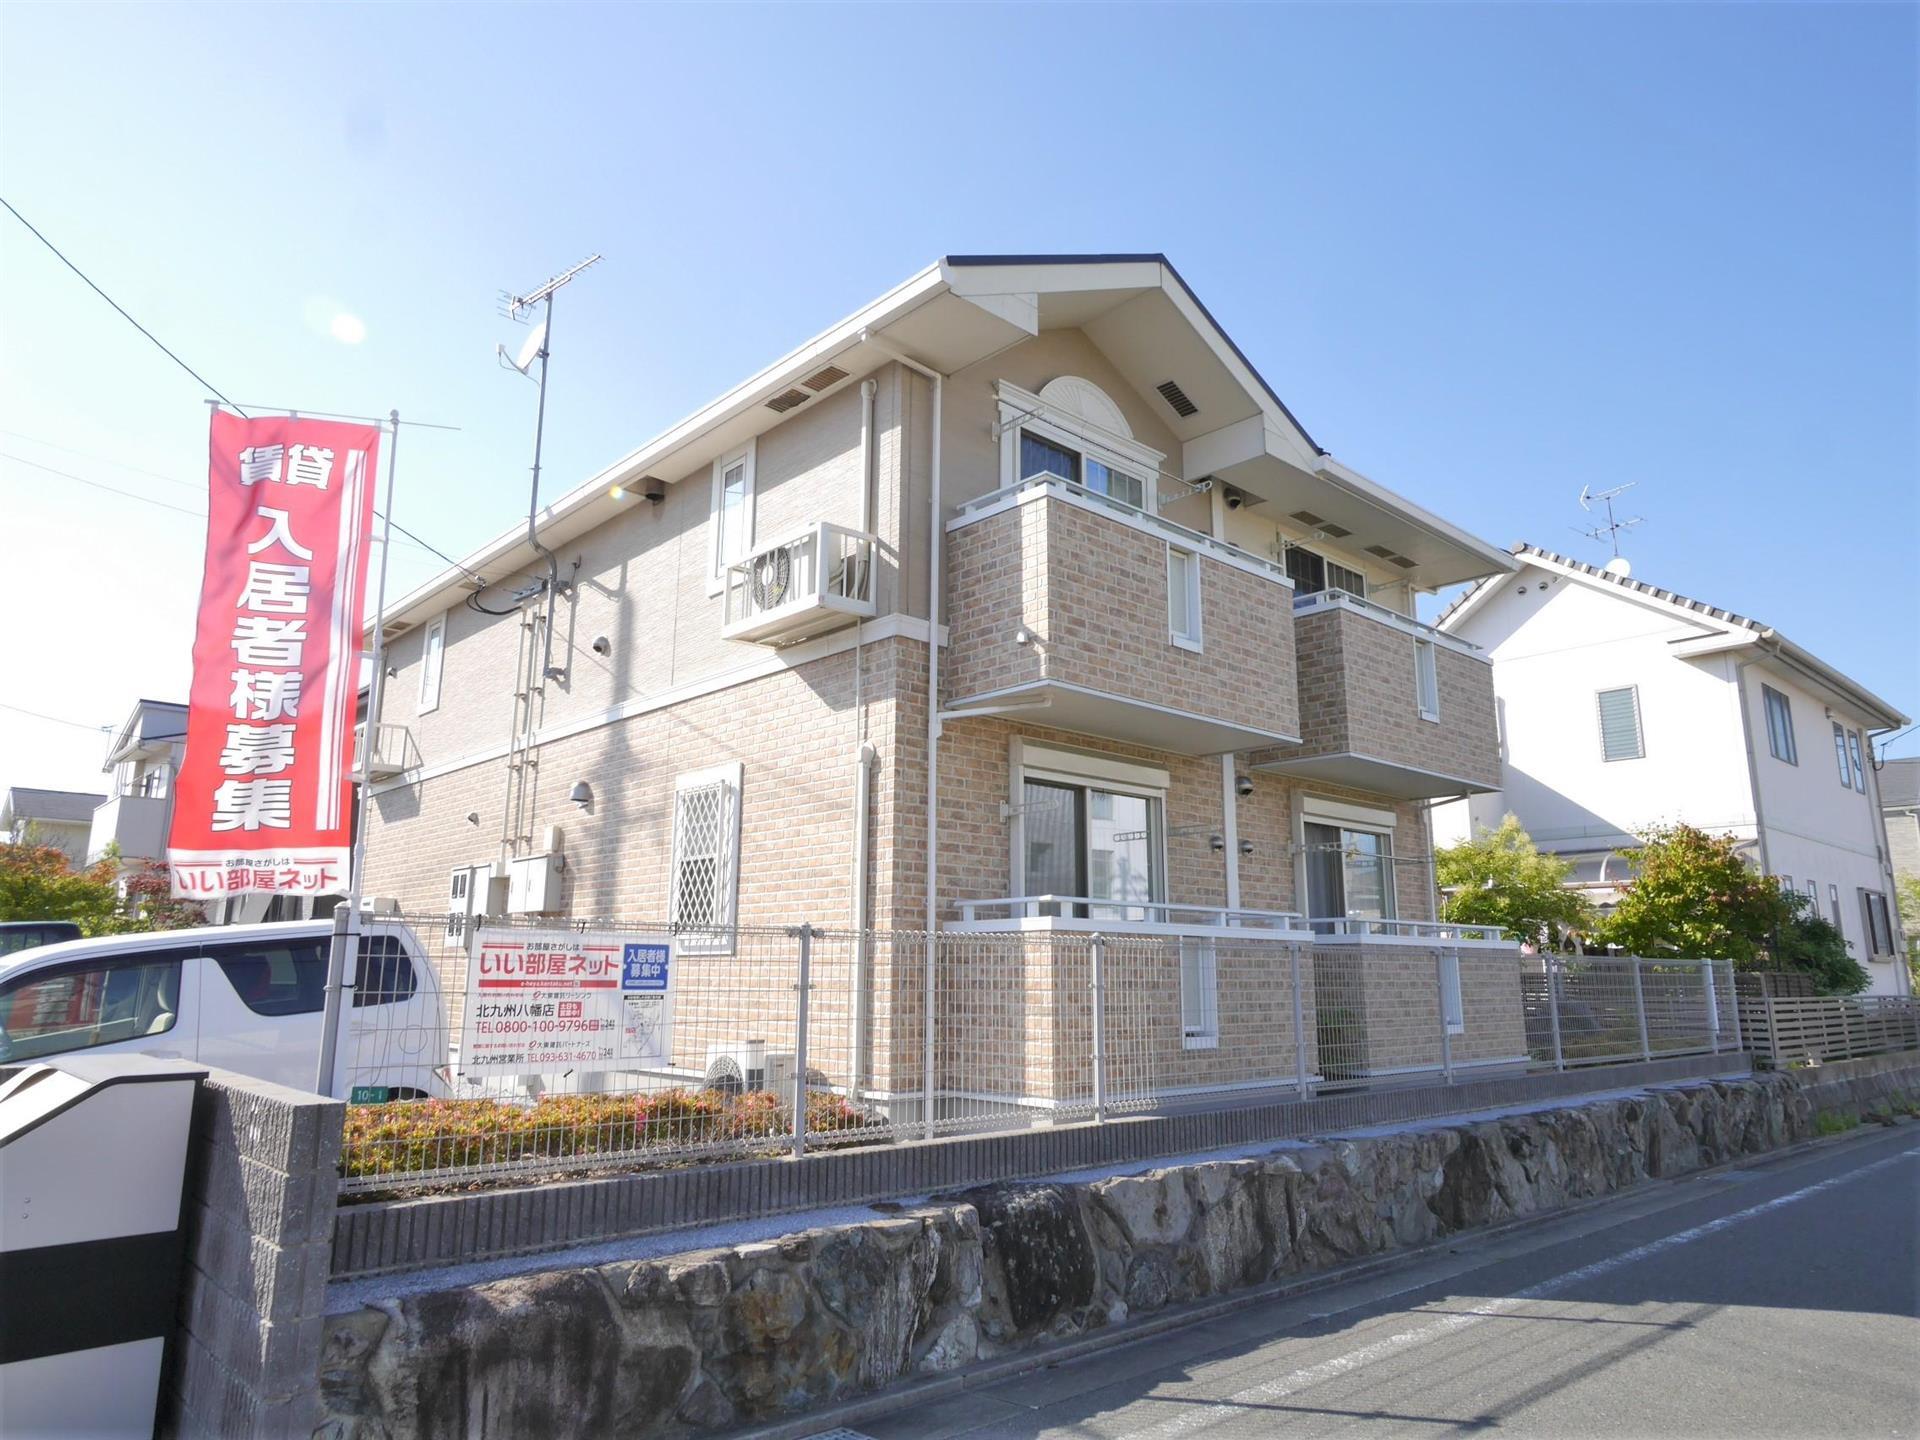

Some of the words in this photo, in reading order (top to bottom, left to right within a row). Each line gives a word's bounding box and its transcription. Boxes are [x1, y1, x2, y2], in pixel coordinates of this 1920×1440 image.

[239, 443, 335, 490] 賃貸
[211, 506, 314, 832] 入居者様募集
[226, 858, 290, 868] お部屋さがしは
[176, 868, 338, 892] いい部屋ネット
[526, 942, 580, 951] お部屋さがしは
[479, 952, 619, 976] いい部屋ネット
[627, 949, 666, 964] 入居者様
[630, 963, 661, 978] 募集中
[476, 1004, 555, 1018] 北九州八幡店
[472, 1054, 523, 1065] 北九州営業所
